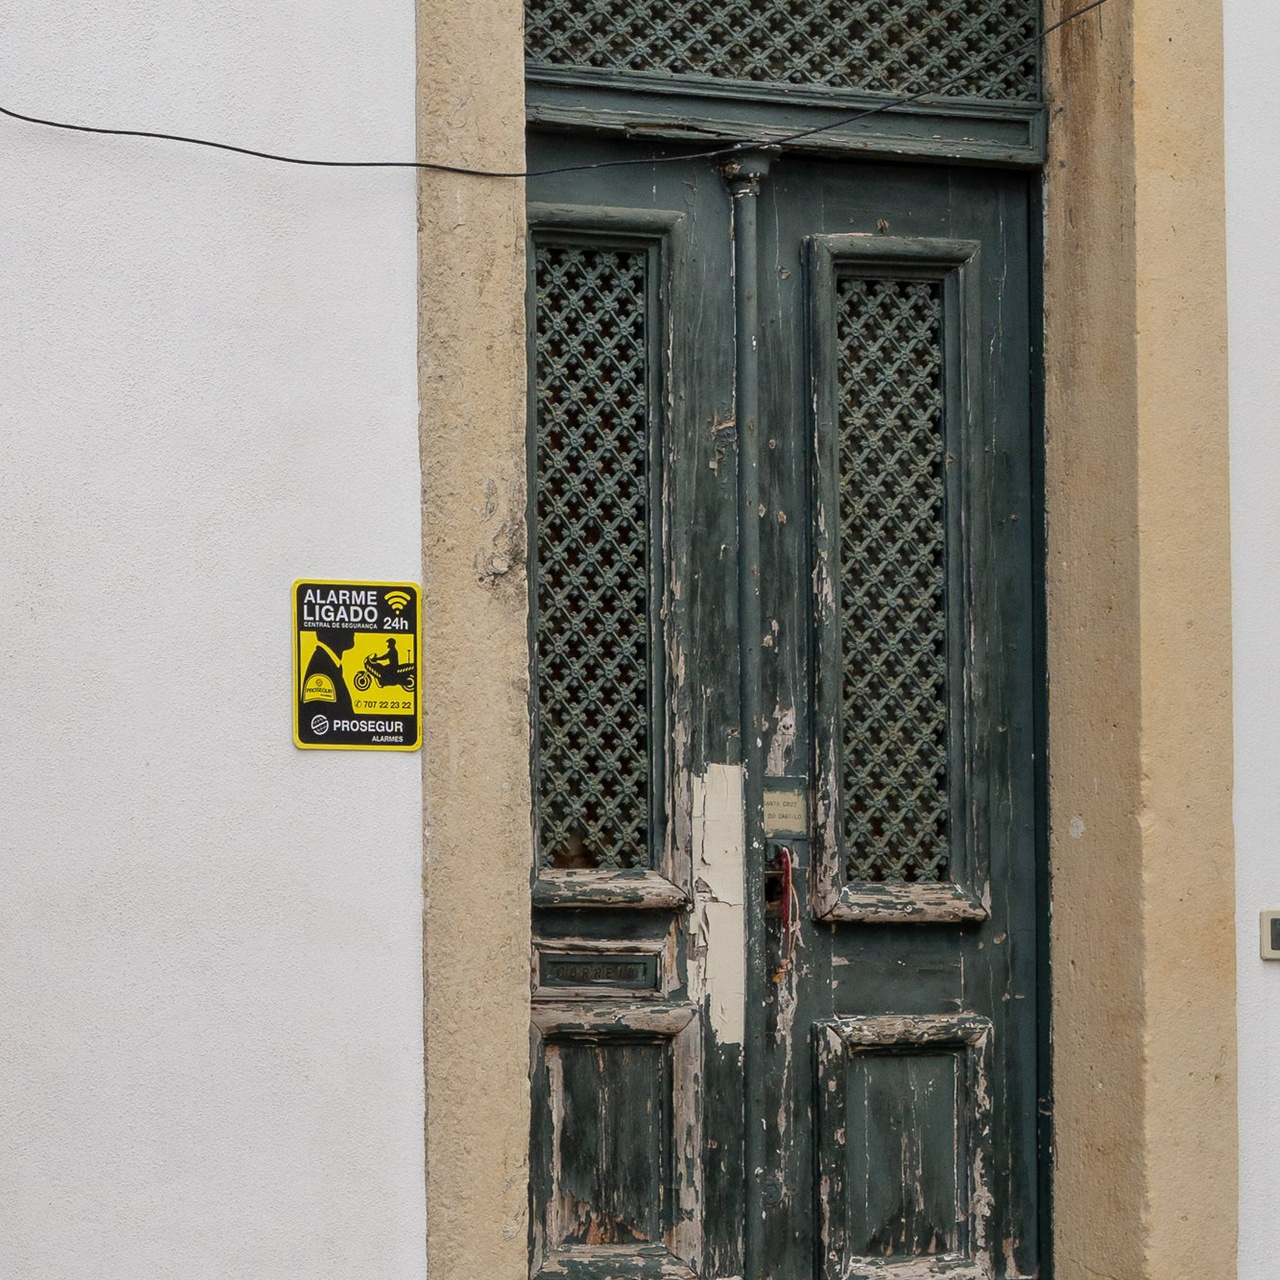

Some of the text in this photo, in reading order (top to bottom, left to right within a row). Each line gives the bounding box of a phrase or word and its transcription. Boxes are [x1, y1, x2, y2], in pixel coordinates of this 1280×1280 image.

[303, 589, 378, 606] ALARME
[303, 605, 378, 623] LIGADO
[383, 616, 409, 630] 24h
[363, 700, 377, 708] 707
[379, 700, 389, 708] 22
[402, 701, 412, 709] 22
[333, 720, 403, 732] PROSEGUR
[372, 735, 403, 743] ALARMES
